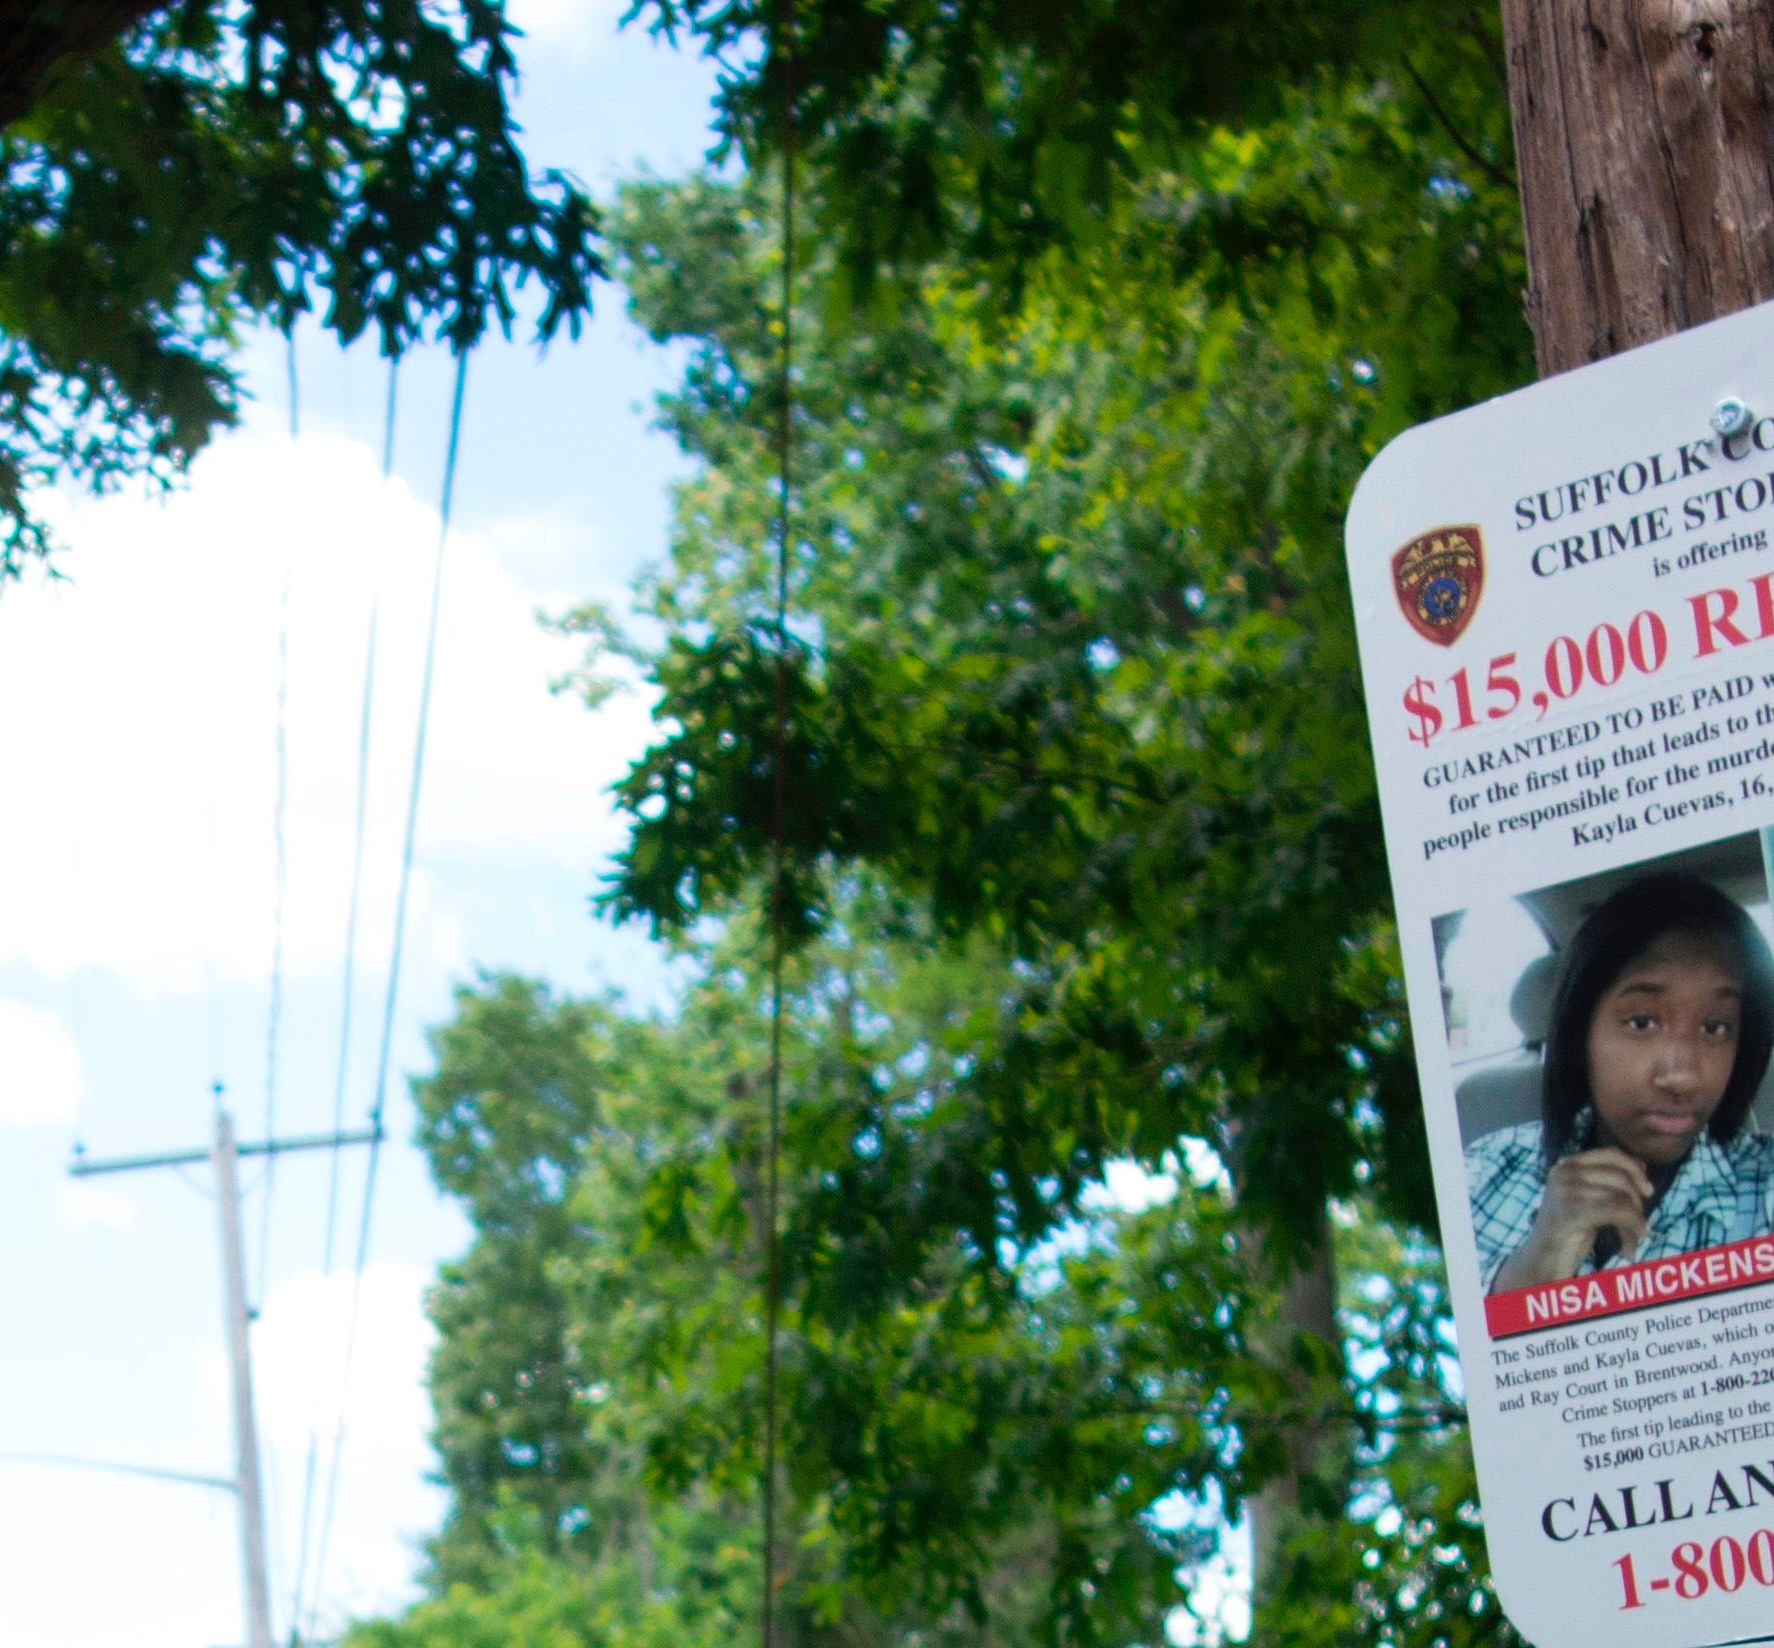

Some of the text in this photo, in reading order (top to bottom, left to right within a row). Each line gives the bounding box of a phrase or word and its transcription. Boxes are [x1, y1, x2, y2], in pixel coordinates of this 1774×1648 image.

[1514, 438, 1713, 531] SUFFOLK
[1531, 506, 1672, 577] CRIME
[1653, 557, 1671, 577] is
[1677, 529, 1768, 569] offering
[1403, 610, 1667, 748] $15,000
[1423, 721, 1600, 788] GUARANTEED
[1606, 708, 1643, 734] TO
[1650, 694, 1685, 722] BE
[1692, 675, 1754, 710] PAID
[1449, 793, 1480, 814] for
[1486, 782, 1519, 804] the
[1526, 765, 1569, 792] first
[1575, 756, 1605, 779] tip
[1612, 740, 1656, 767] that
[1663, 721, 1720, 753] leads
[1726, 716, 1749, 734] to
[1423, 821, 1491, 860] people
[1498, 785, 1619, 834] responsible
[1626, 775, 1658, 798] for
[1665, 764, 1699, 786] the
[1572, 814, 1637, 846] Kayla
[1643, 791, 1733, 825] Cuevas,
[1740, 775, 1774, 799] 16,
[1525, 1280, 1607, 1322] NISA
[1491, 1349, 1520, 1365] The
[1525, 1335, 1579, 1359] Suffolk
[1584, 1326, 1638, 1346] County
[1645, 1314, 1692, 1334] Police
[1561, 1405, 1607, 1422] Crime
[1612, 1392, 1677, 1413] Stoppers
[1683, 1386, 1695, 1399] at
[1541, 1479, 1693, 1542] CALL
